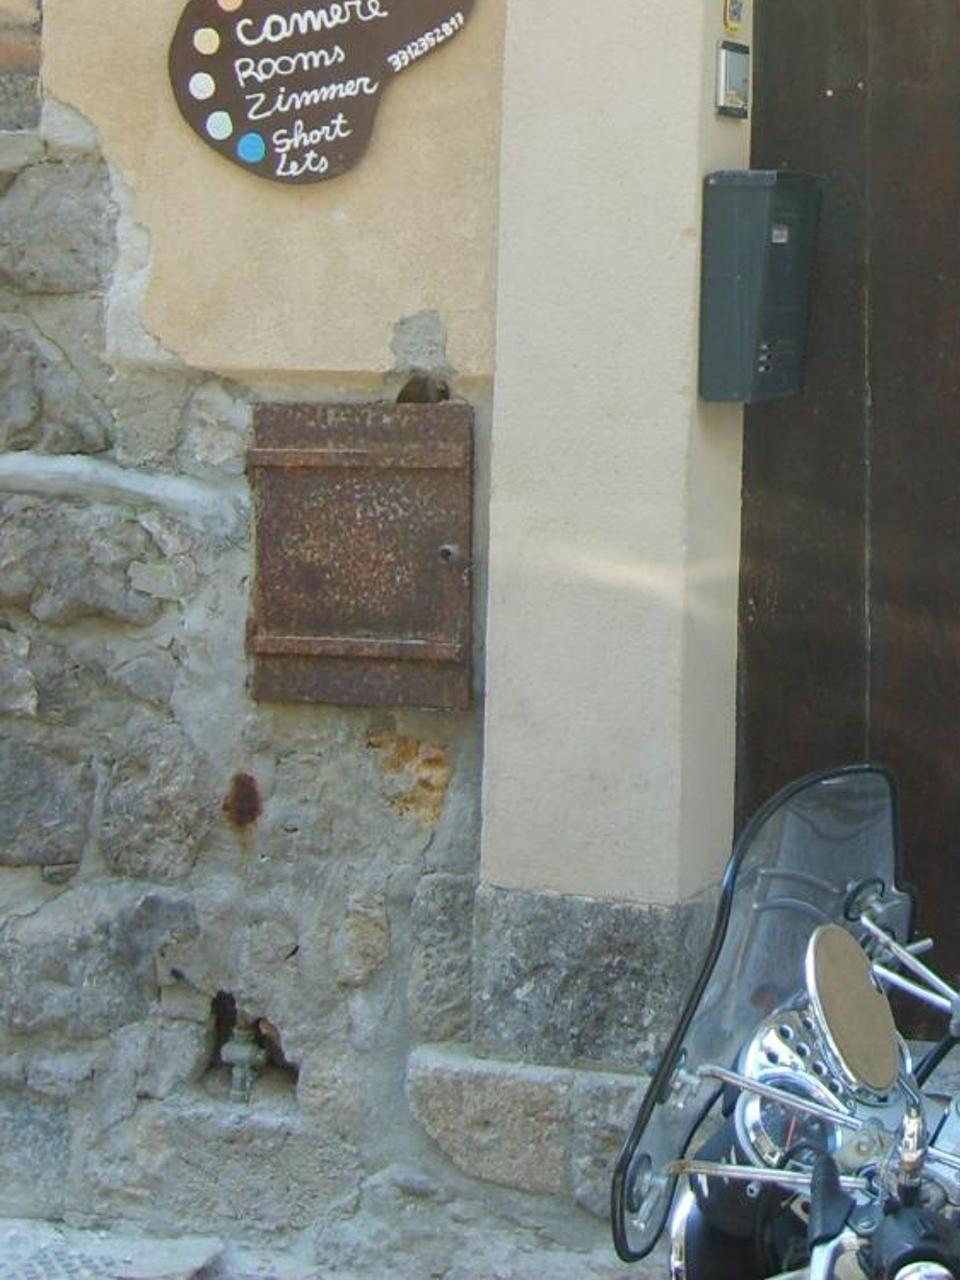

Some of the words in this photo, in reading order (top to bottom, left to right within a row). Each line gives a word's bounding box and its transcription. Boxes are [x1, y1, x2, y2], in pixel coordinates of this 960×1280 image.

[234, 45, 346, 88] Rooms
[245, 76, 379, 120] Zimmer
[272, 112, 352, 152] Short
[275, 150, 329, 176] Lets
